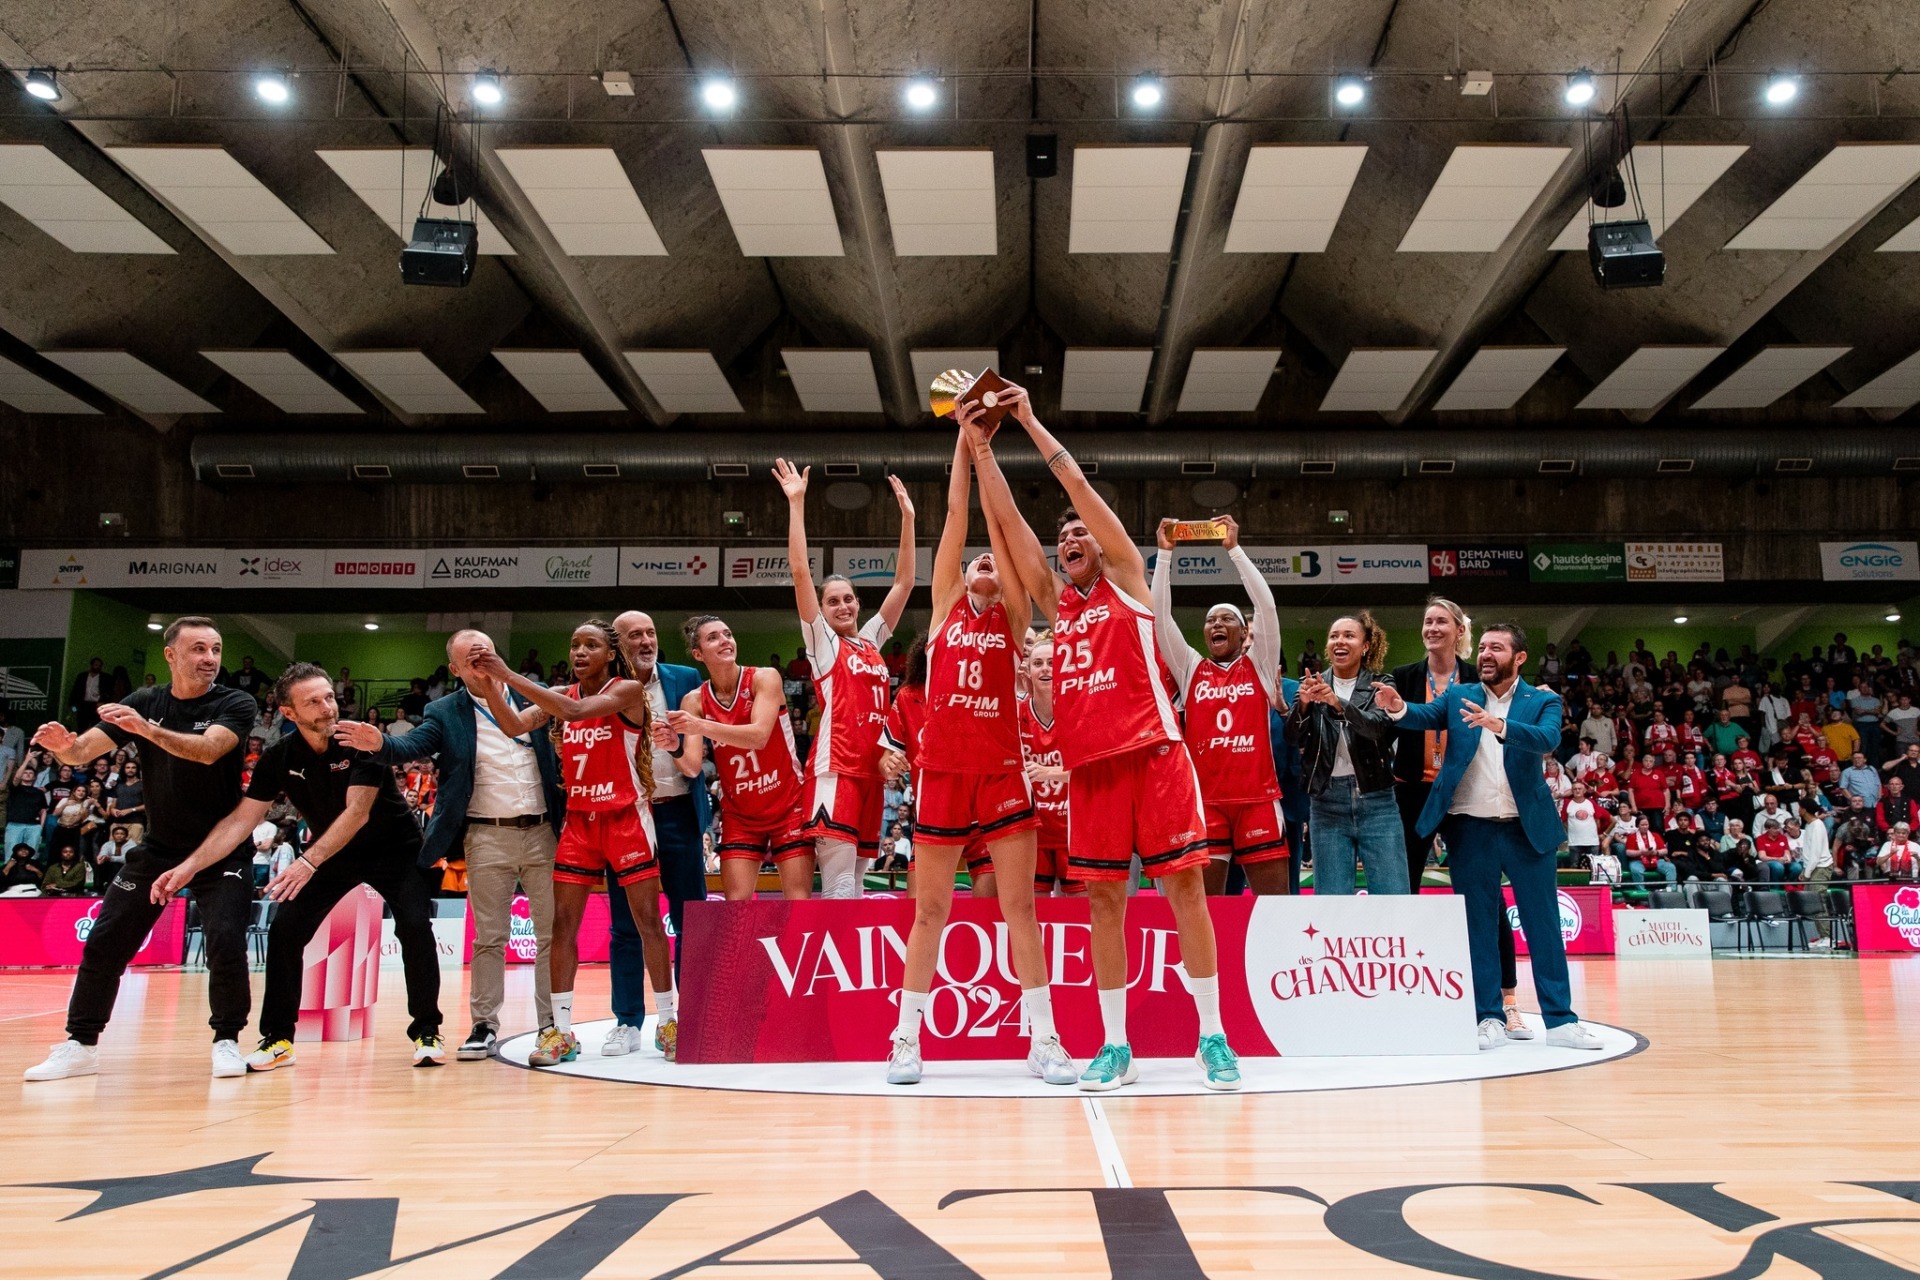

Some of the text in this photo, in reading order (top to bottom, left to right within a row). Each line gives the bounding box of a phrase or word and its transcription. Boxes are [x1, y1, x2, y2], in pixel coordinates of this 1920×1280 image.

[455, 556, 518, 567] KAUFMAN
[1459, 550, 1524, 560] DEMATHIEU
[1552, 553, 1622, 565] hauts-de-seine
[129, 561, 217, 574] MARIGNAN
[264, 557, 302, 572] idex
[335, 562, 416, 575] LAMOTTE
[632, 562, 682, 570] VINCI
[757, 557, 816, 569] EIFFE
[1178, 557, 1215, 567] GTM
[1248, 557, 1287, 567] ouygues
[1362, 559, 1423, 569] EUROVIA
[1459, 560, 1491, 569] BARD
[455, 568, 500, 579] BROAD
[1178, 567, 1222, 575] BÂTIMENT
[1852, 569, 1894, 578] Solutions
[1057, 639, 1093, 673] 25
[957, 659, 984, 690] 18
[1061, 667, 1115, 695] PHM
[1088, 682, 1118, 695] GROUP
[1195, 680, 1254, 703] Bourges
[872, 685, 884, 710] 11
[948, 694, 999, 711] PHM
[868, 712, 888, 725] PH
[1216, 708, 1232, 732] 0
[1210, 735, 1254, 749] PHM
[1023, 744, 1063, 767] Bourg
[572, 753, 588, 780] 7
[730, 749, 761, 779] 21
[736, 769, 778, 795] PHM
[758, 780, 781, 795] GROUP
[570, 782, 613, 798] PHM
[590, 793, 617, 803] GROUP
[1037, 800, 1068, 811] PH
[1648, 922, 1681, 930] MATCH
[510, 938, 537, 947] WON
[1628, 930, 1703, 946] CHAMPIONS
[519, 948, 536, 957] LIG
[1323, 936, 1406, 958] MATCH
[1298, 955, 1314, 966] des
[1270, 957, 1464, 1000] CHAMPIONS
